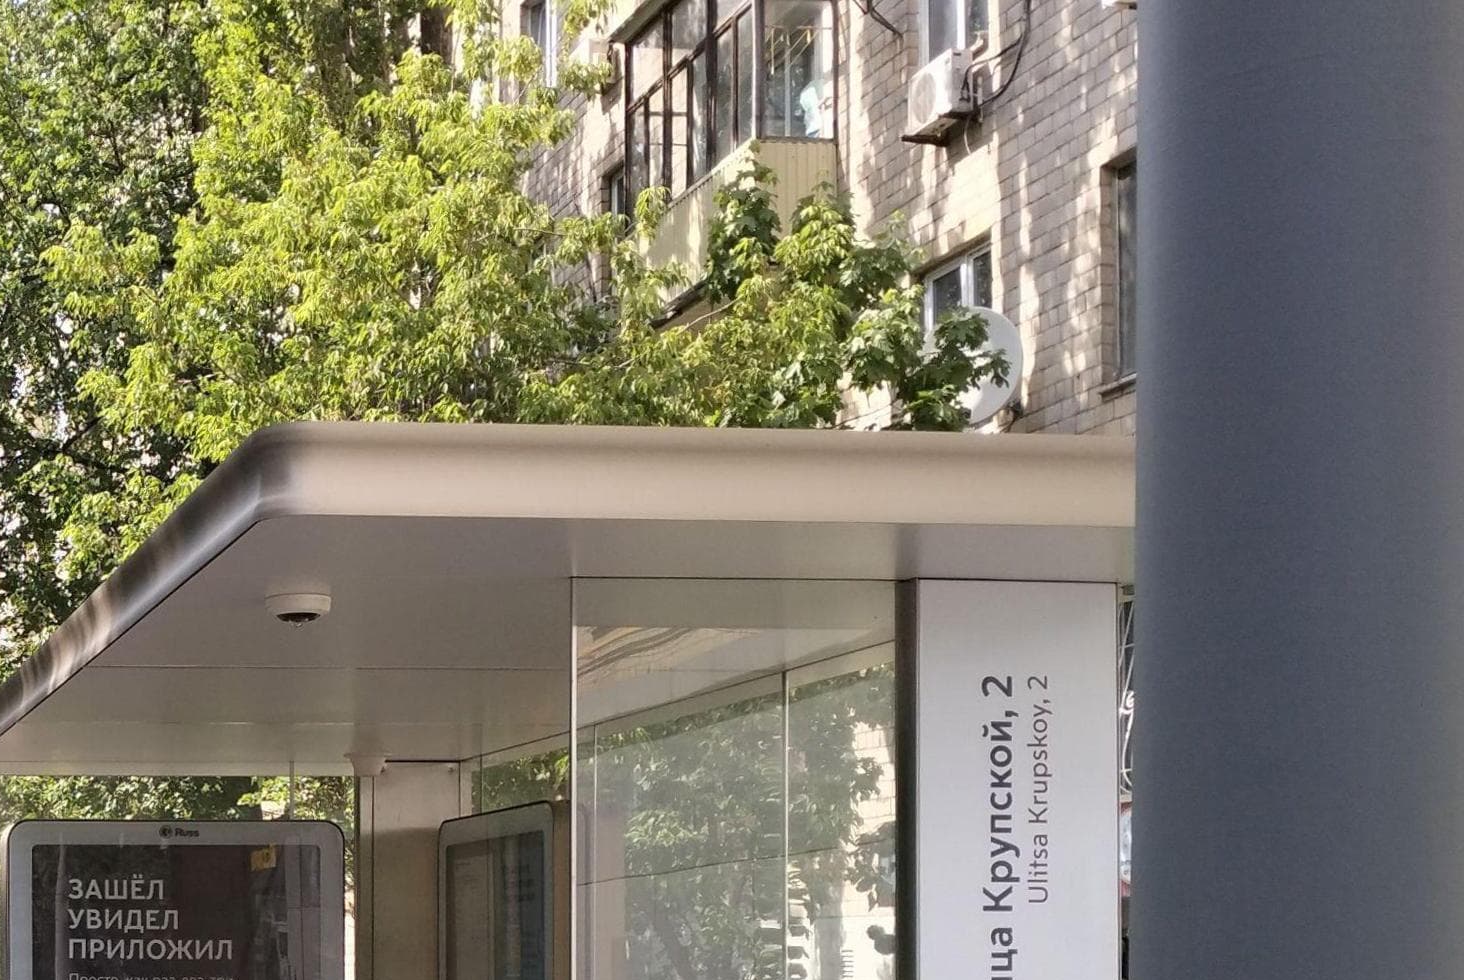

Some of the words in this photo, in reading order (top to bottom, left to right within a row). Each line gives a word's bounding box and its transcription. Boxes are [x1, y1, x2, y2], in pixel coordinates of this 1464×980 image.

[981, 674, 1014, 697] 2
[1026, 674, 1049, 690] 2
[1026, 695, 1053, 824] Krupskoy,
[981, 710, 1020, 912] Крупской,
[1027, 830, 1049, 904] Ulitsa
[68, 873, 164, 900] ЗАШЁЛ
[67, 908, 179, 934] УВИДЕЛ
[68, 938, 233, 960] ПРИЛОЖИЛ
